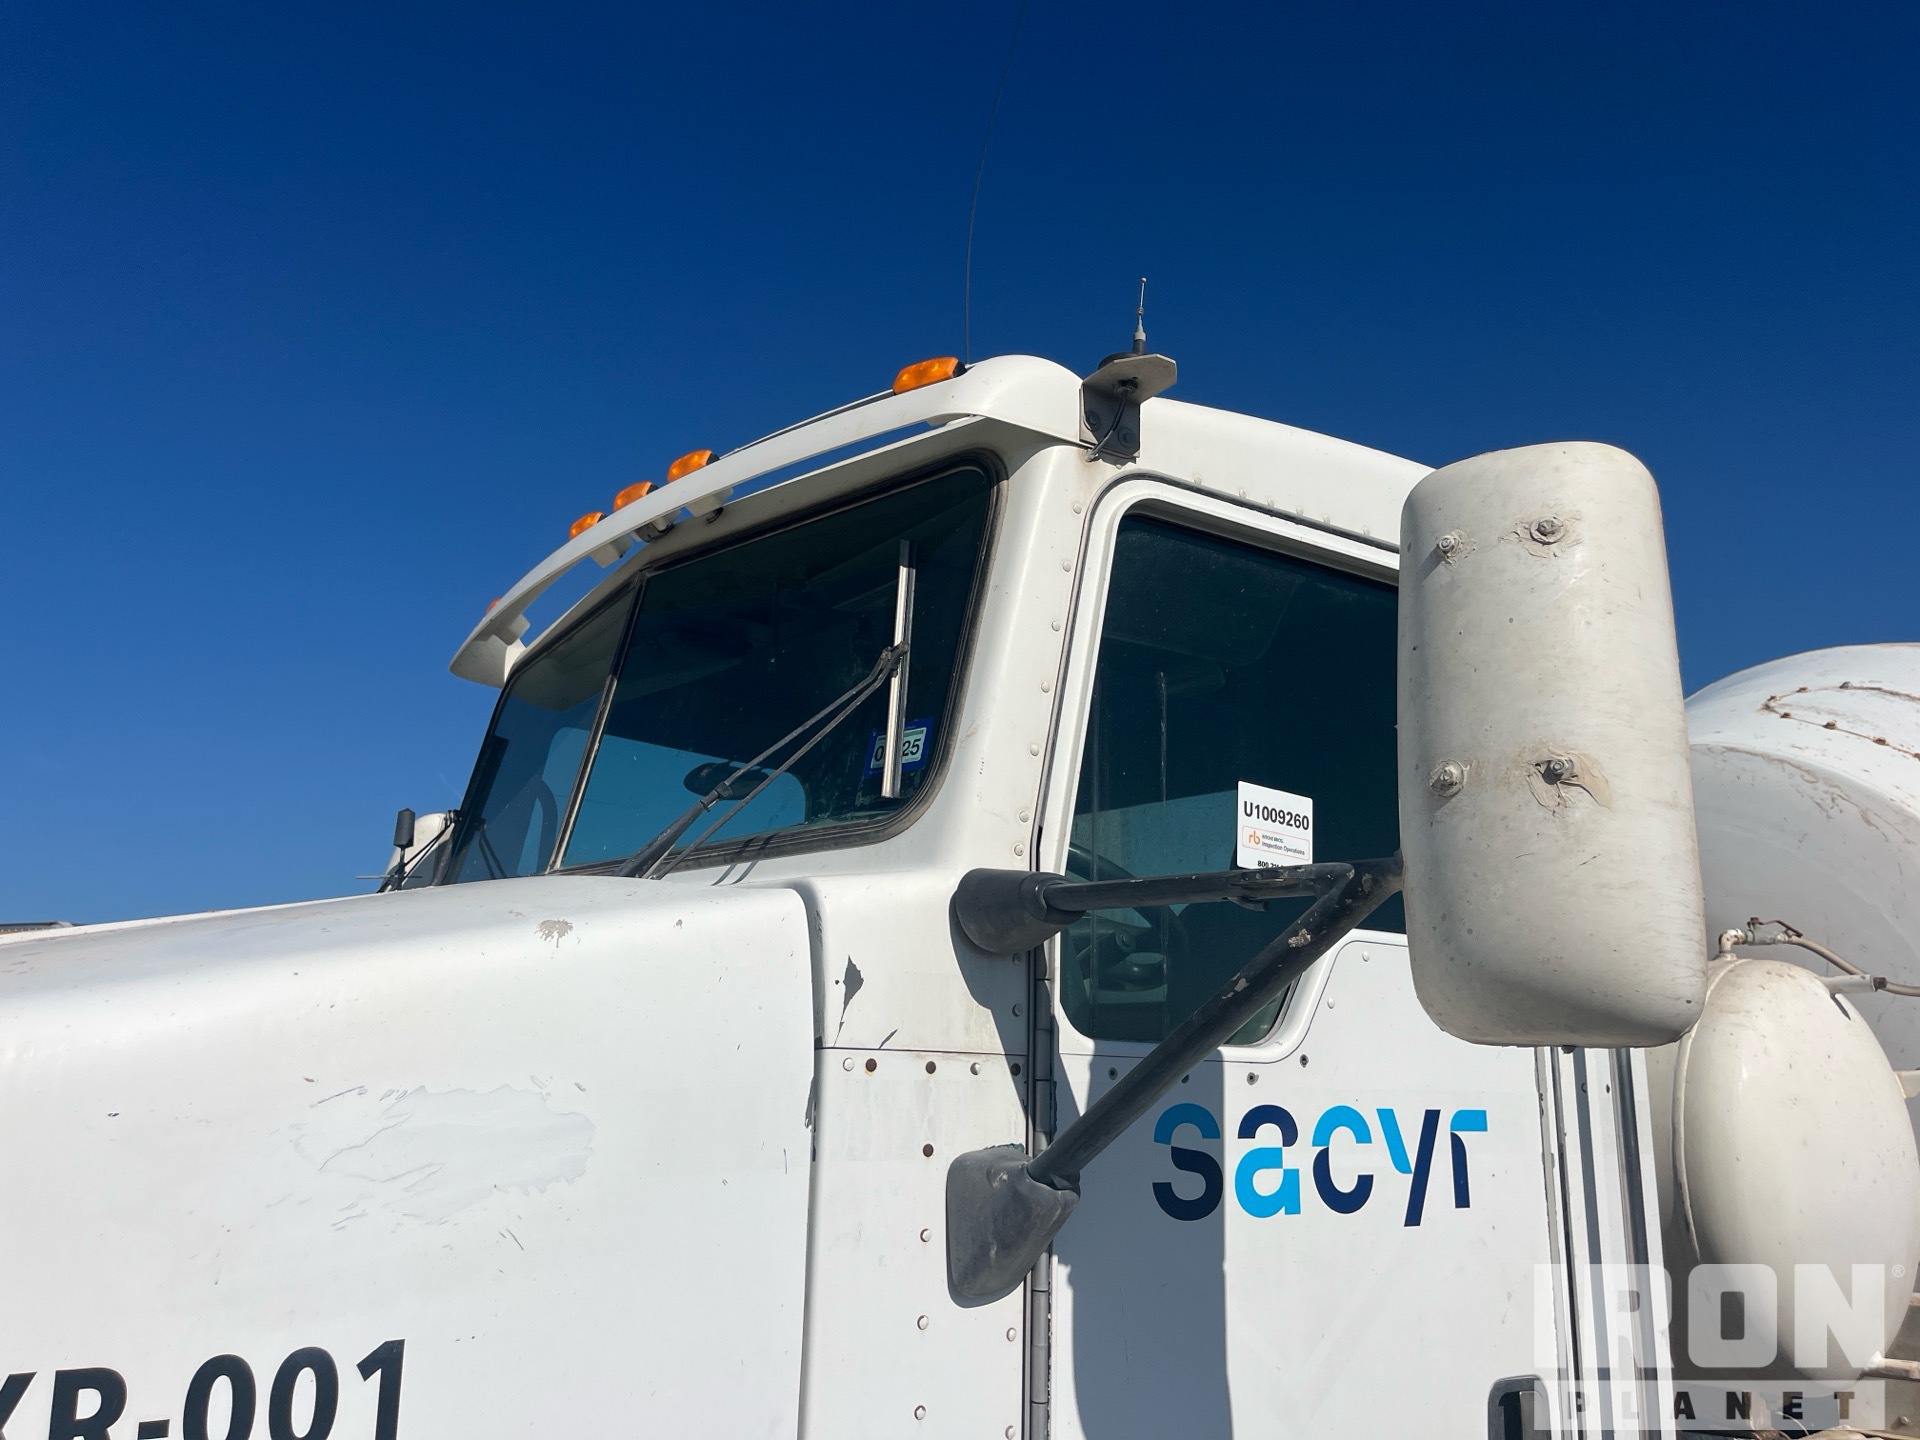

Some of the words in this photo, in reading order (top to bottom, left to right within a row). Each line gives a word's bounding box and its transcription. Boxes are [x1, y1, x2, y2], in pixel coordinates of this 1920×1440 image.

[902, 738, 922, 757] 25
[1243, 801, 1310, 831] U1009260
[1152, 1103, 1488, 1227] sacyr
